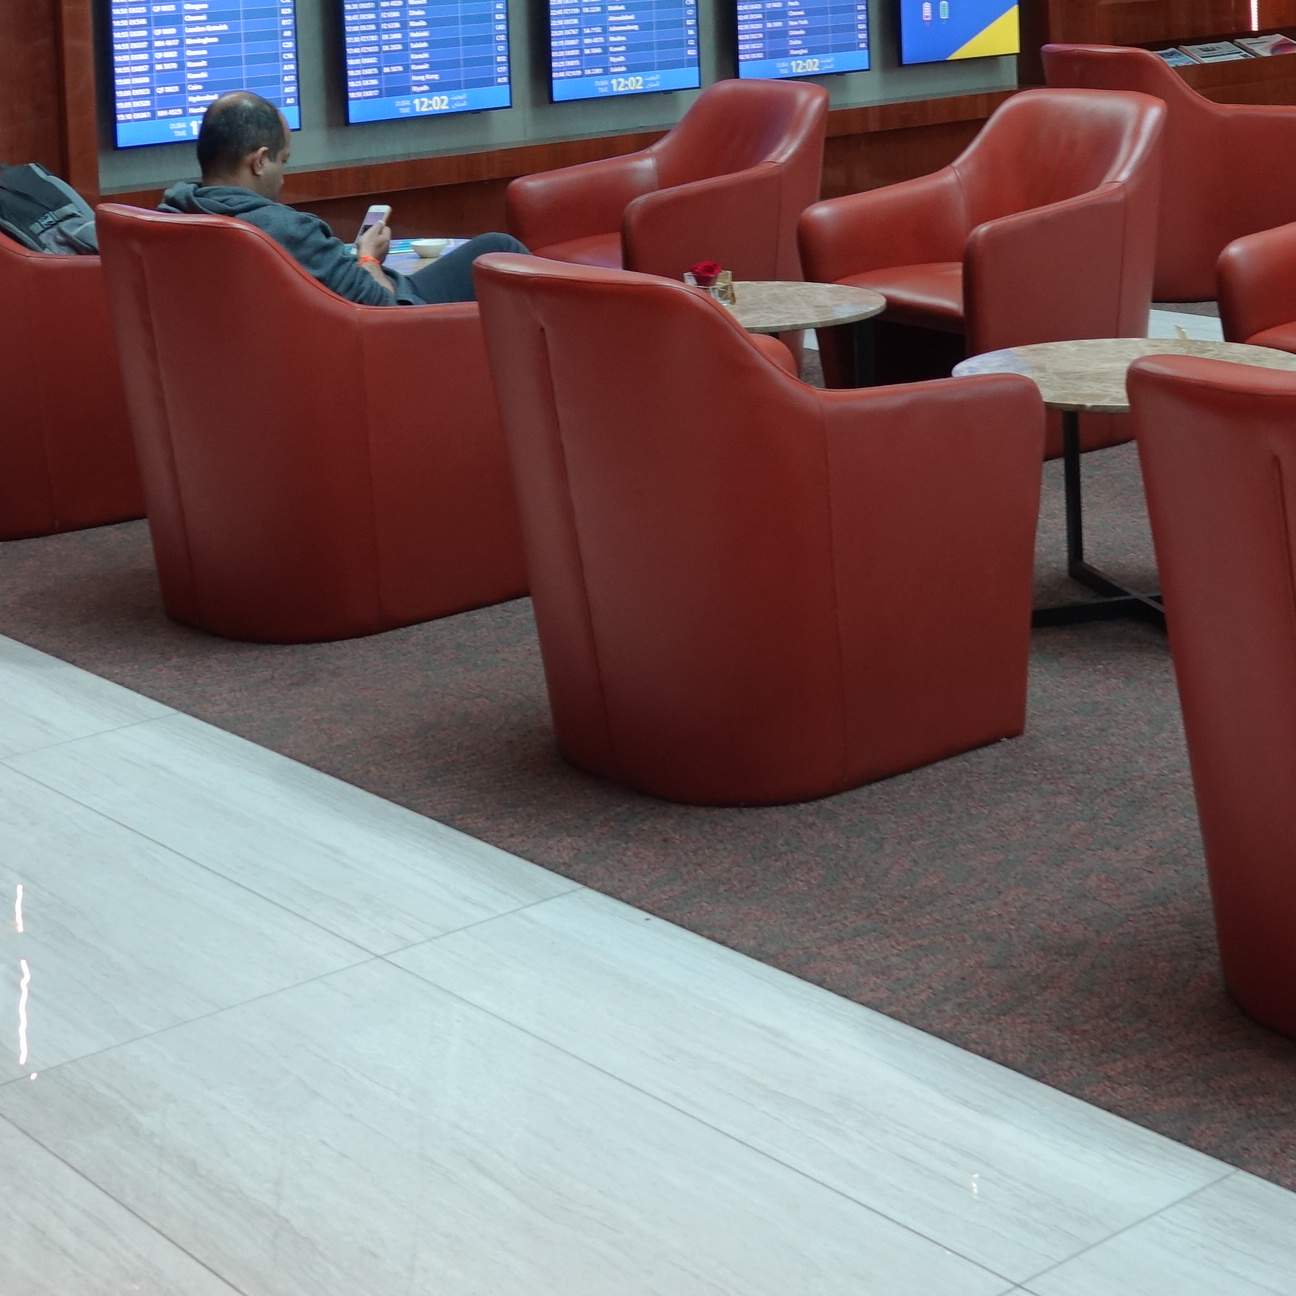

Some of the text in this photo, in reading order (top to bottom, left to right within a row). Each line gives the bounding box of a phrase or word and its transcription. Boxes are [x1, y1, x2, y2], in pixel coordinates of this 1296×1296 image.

[789, 58, 820, 73] 12:02
[609, 75, 644, 92] 12:02
[412, 94, 449, 112] 12:02
